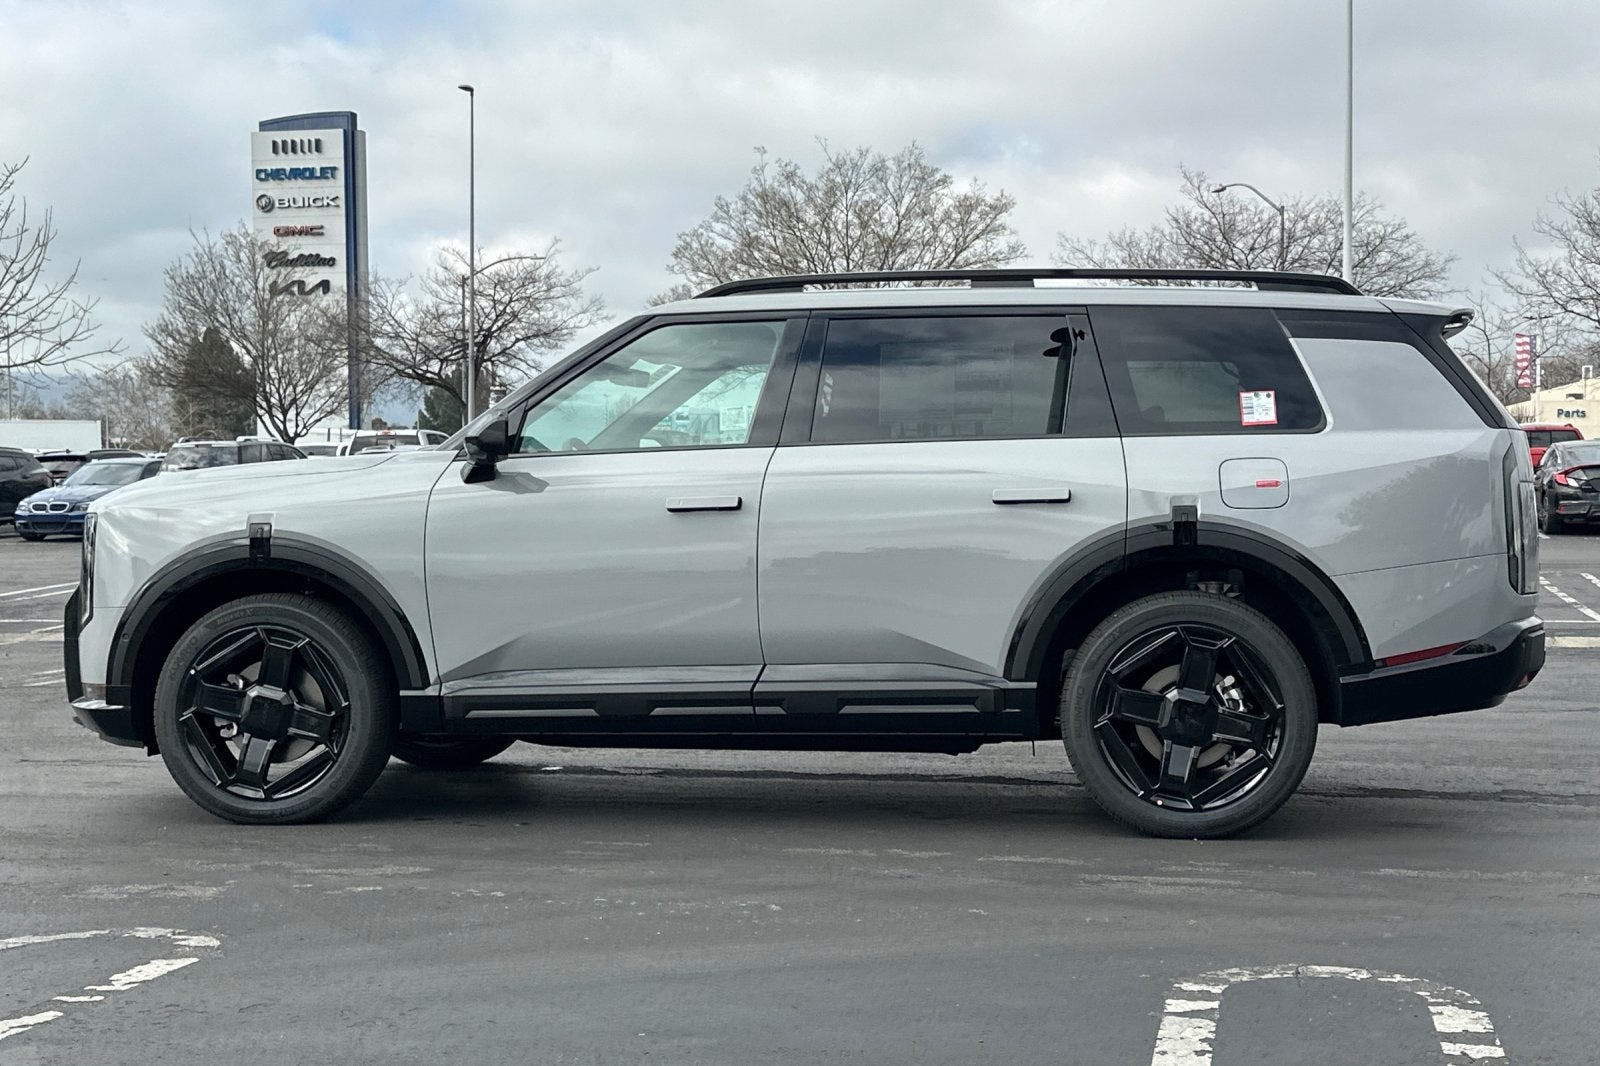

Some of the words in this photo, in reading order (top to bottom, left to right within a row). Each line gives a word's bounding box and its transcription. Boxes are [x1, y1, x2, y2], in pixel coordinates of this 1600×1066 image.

[256, 166, 338, 181] CHEVROLET
[275, 195, 340, 209] BUICK
[273, 225, 324, 237] GMC
[264, 251, 336, 269] Cadillac
[1557, 408, 1587, 418] Parts
